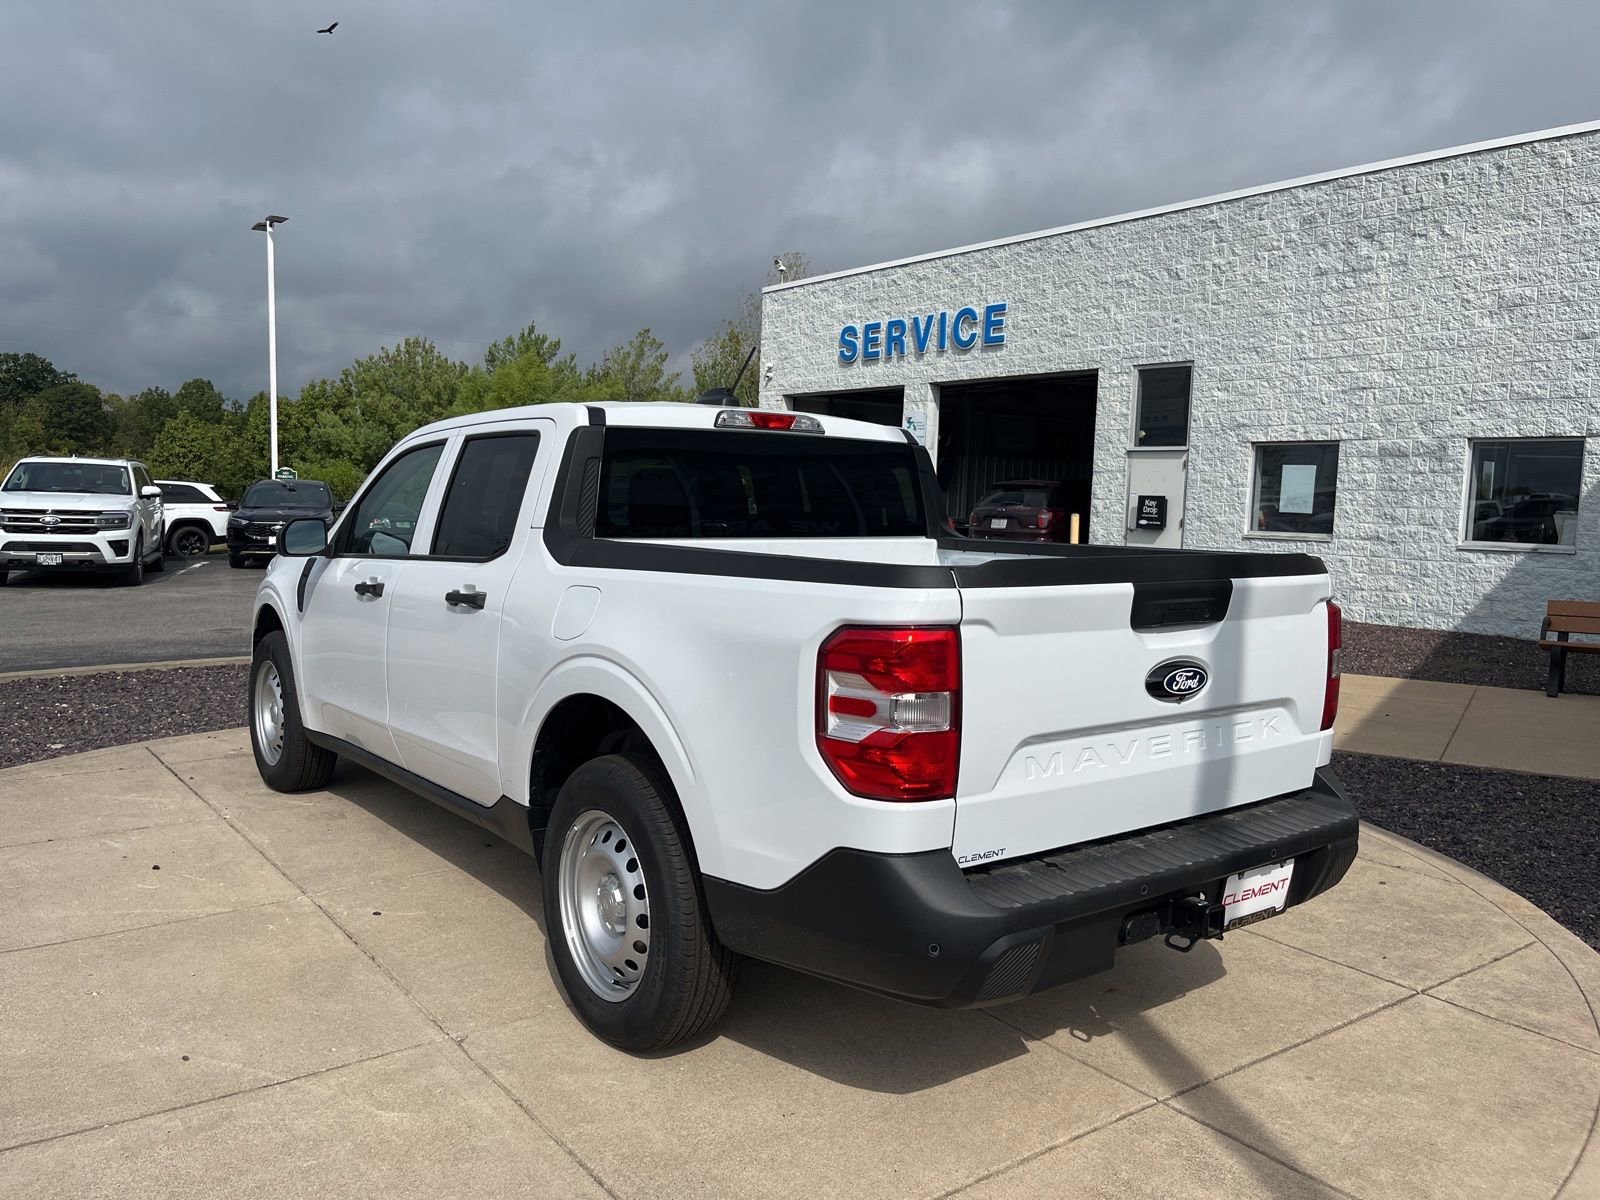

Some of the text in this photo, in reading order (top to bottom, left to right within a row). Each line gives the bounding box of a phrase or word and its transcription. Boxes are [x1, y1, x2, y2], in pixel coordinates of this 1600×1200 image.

[839, 302, 1008, 363] SERVICE
[1142, 506, 1158, 515] Drop
[1144, 499, 1157, 508] Key
[1172, 671, 1200, 691] Ford
[1025, 716, 1281, 780] MAVERICK
[958, 847, 1006, 864] CLEMENT
[1223, 877, 1289, 906] CLEMENT
[1229, 908, 1275, 930] CLEMENT
